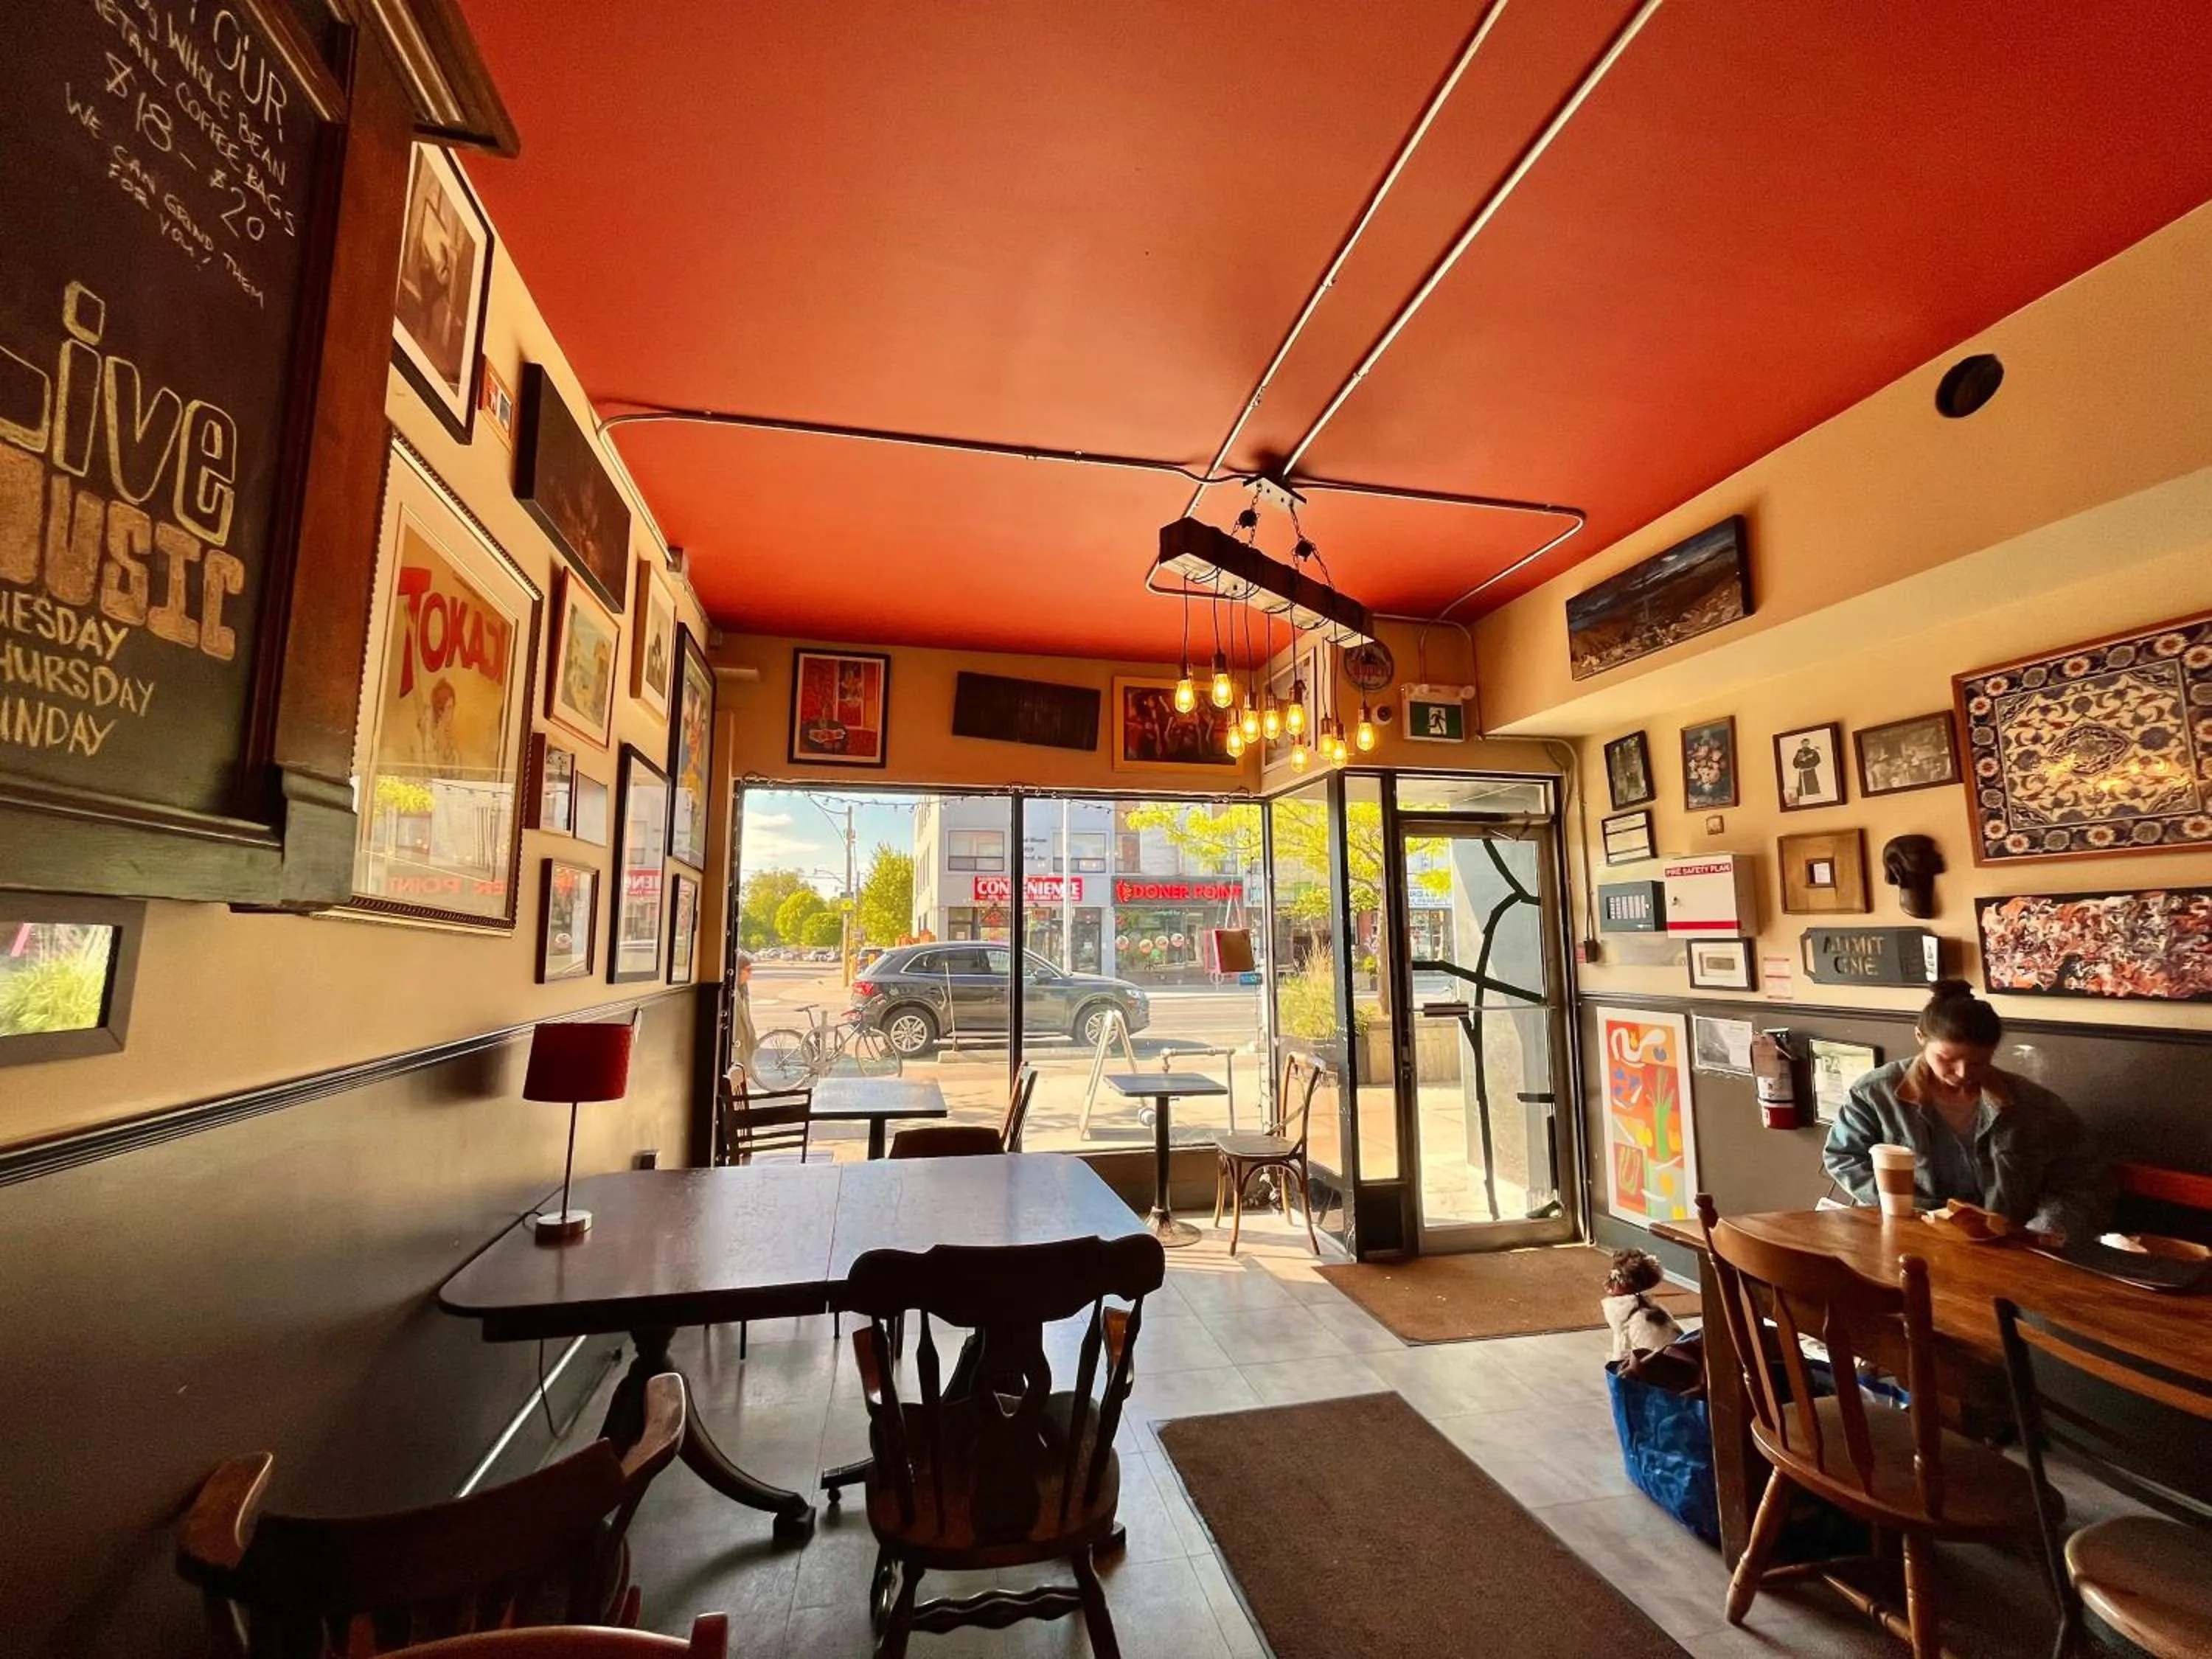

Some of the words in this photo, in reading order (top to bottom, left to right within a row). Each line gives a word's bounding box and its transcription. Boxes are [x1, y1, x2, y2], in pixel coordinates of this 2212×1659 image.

[167, 12, 231, 119] WHOLE
[238, 111, 286, 185] BEAN
[175, 82, 242, 173] COFFEE
[243, 163, 295, 236] BAGS
[66, 83, 103, 139] WE
[113, 145, 156, 195] CAN
[223, 251, 263, 308] THEM
[1666, 868, 1682, 877] FIRE
[1683, 866, 1708, 875] SAFETY
[1710, 863, 1731, 874] PLAN
[977, 880, 1080, 895] CONNIENE
[1133, 883, 1189, 899] DONER
[1194, 884, 1242, 899] POINT
[1823, 935, 1885, 956] ADMIT
[1834, 956, 1879, 976] ONE
